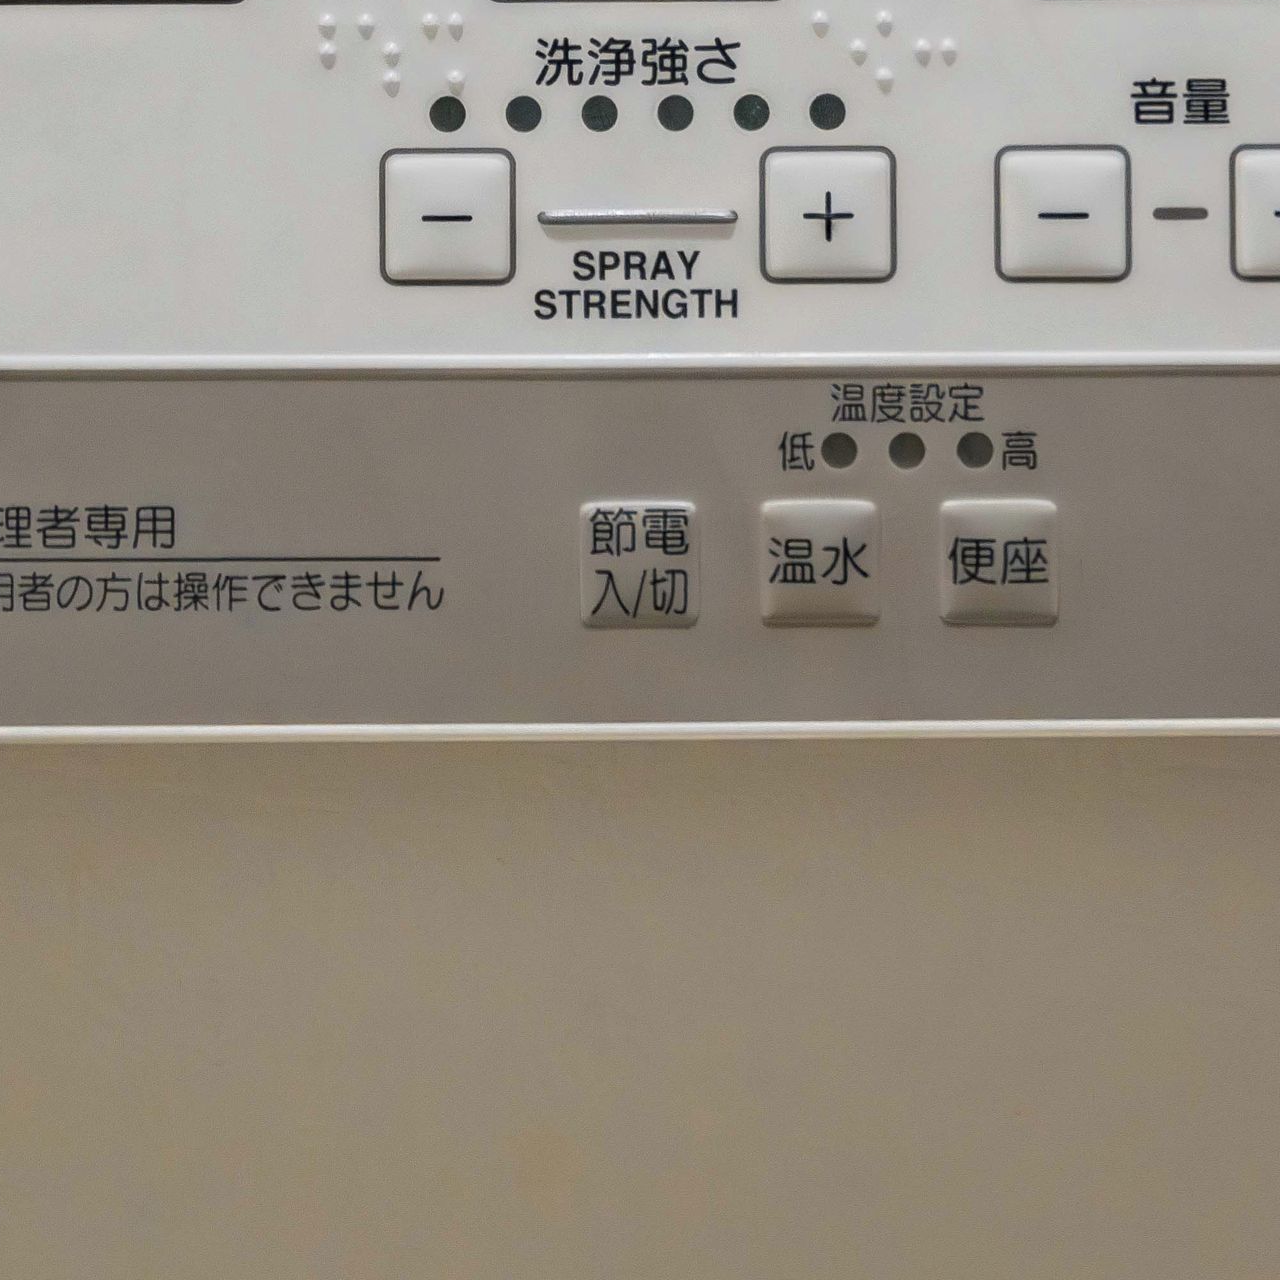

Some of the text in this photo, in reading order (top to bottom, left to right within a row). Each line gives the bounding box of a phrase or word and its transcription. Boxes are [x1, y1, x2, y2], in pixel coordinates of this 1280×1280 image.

[535, 36, 741, 87] 洗浄強さ
[1130, 77, 1230, 125] 音量
[572, 250, 701, 282] SPRAY
[534, 288, 738, 320] STRENGTH
[831, 382, 985, 424] 温度設定
[778, 431, 815, 471] 低
[1001, 430, 1038, 471] 高
[589, 508, 690, 557] 節電
[769, 536, 870, 586] 温水
[948, 536, 1049, 585] 便座
